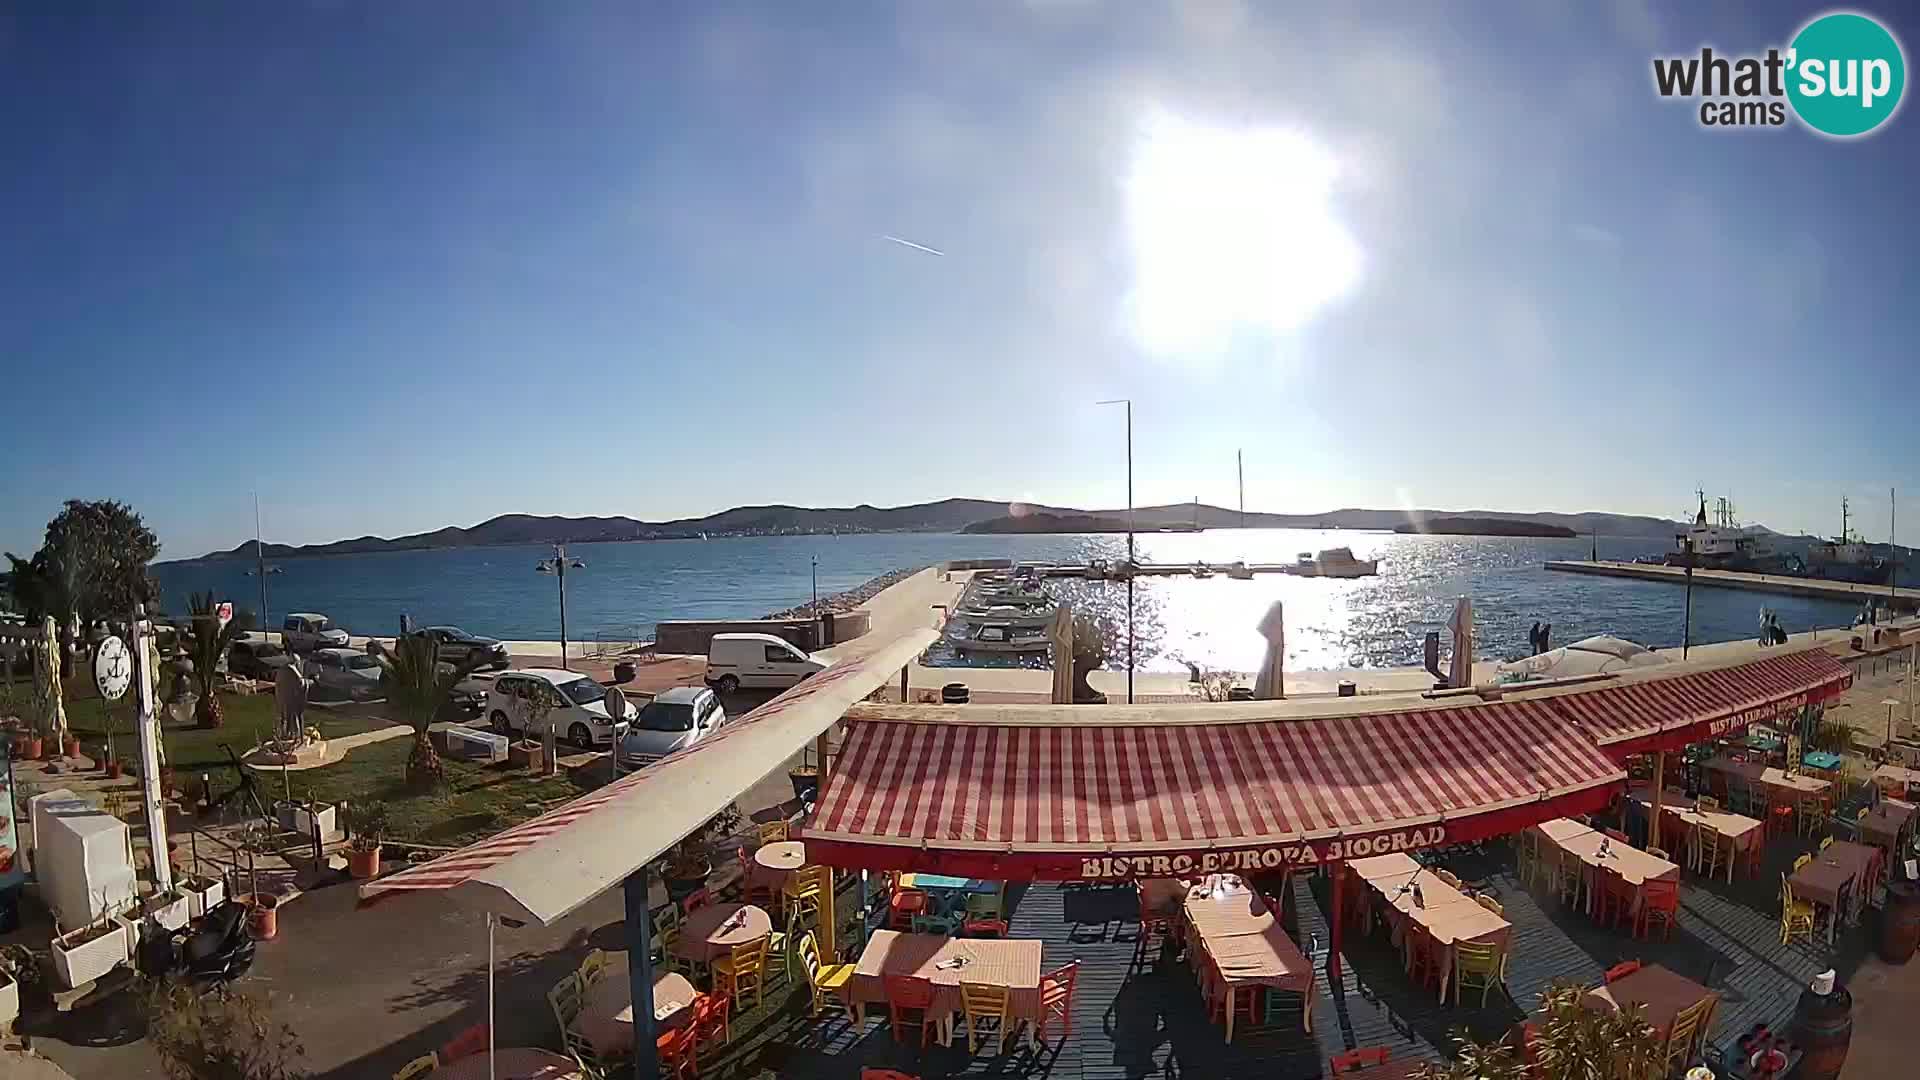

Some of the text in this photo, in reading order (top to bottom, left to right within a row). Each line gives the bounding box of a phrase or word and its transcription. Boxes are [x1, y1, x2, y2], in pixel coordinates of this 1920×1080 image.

[1708, 713, 1744, 735] BISTRO
[1081, 826, 1446, 878] BISTRO EUROPA BIOGRAD
